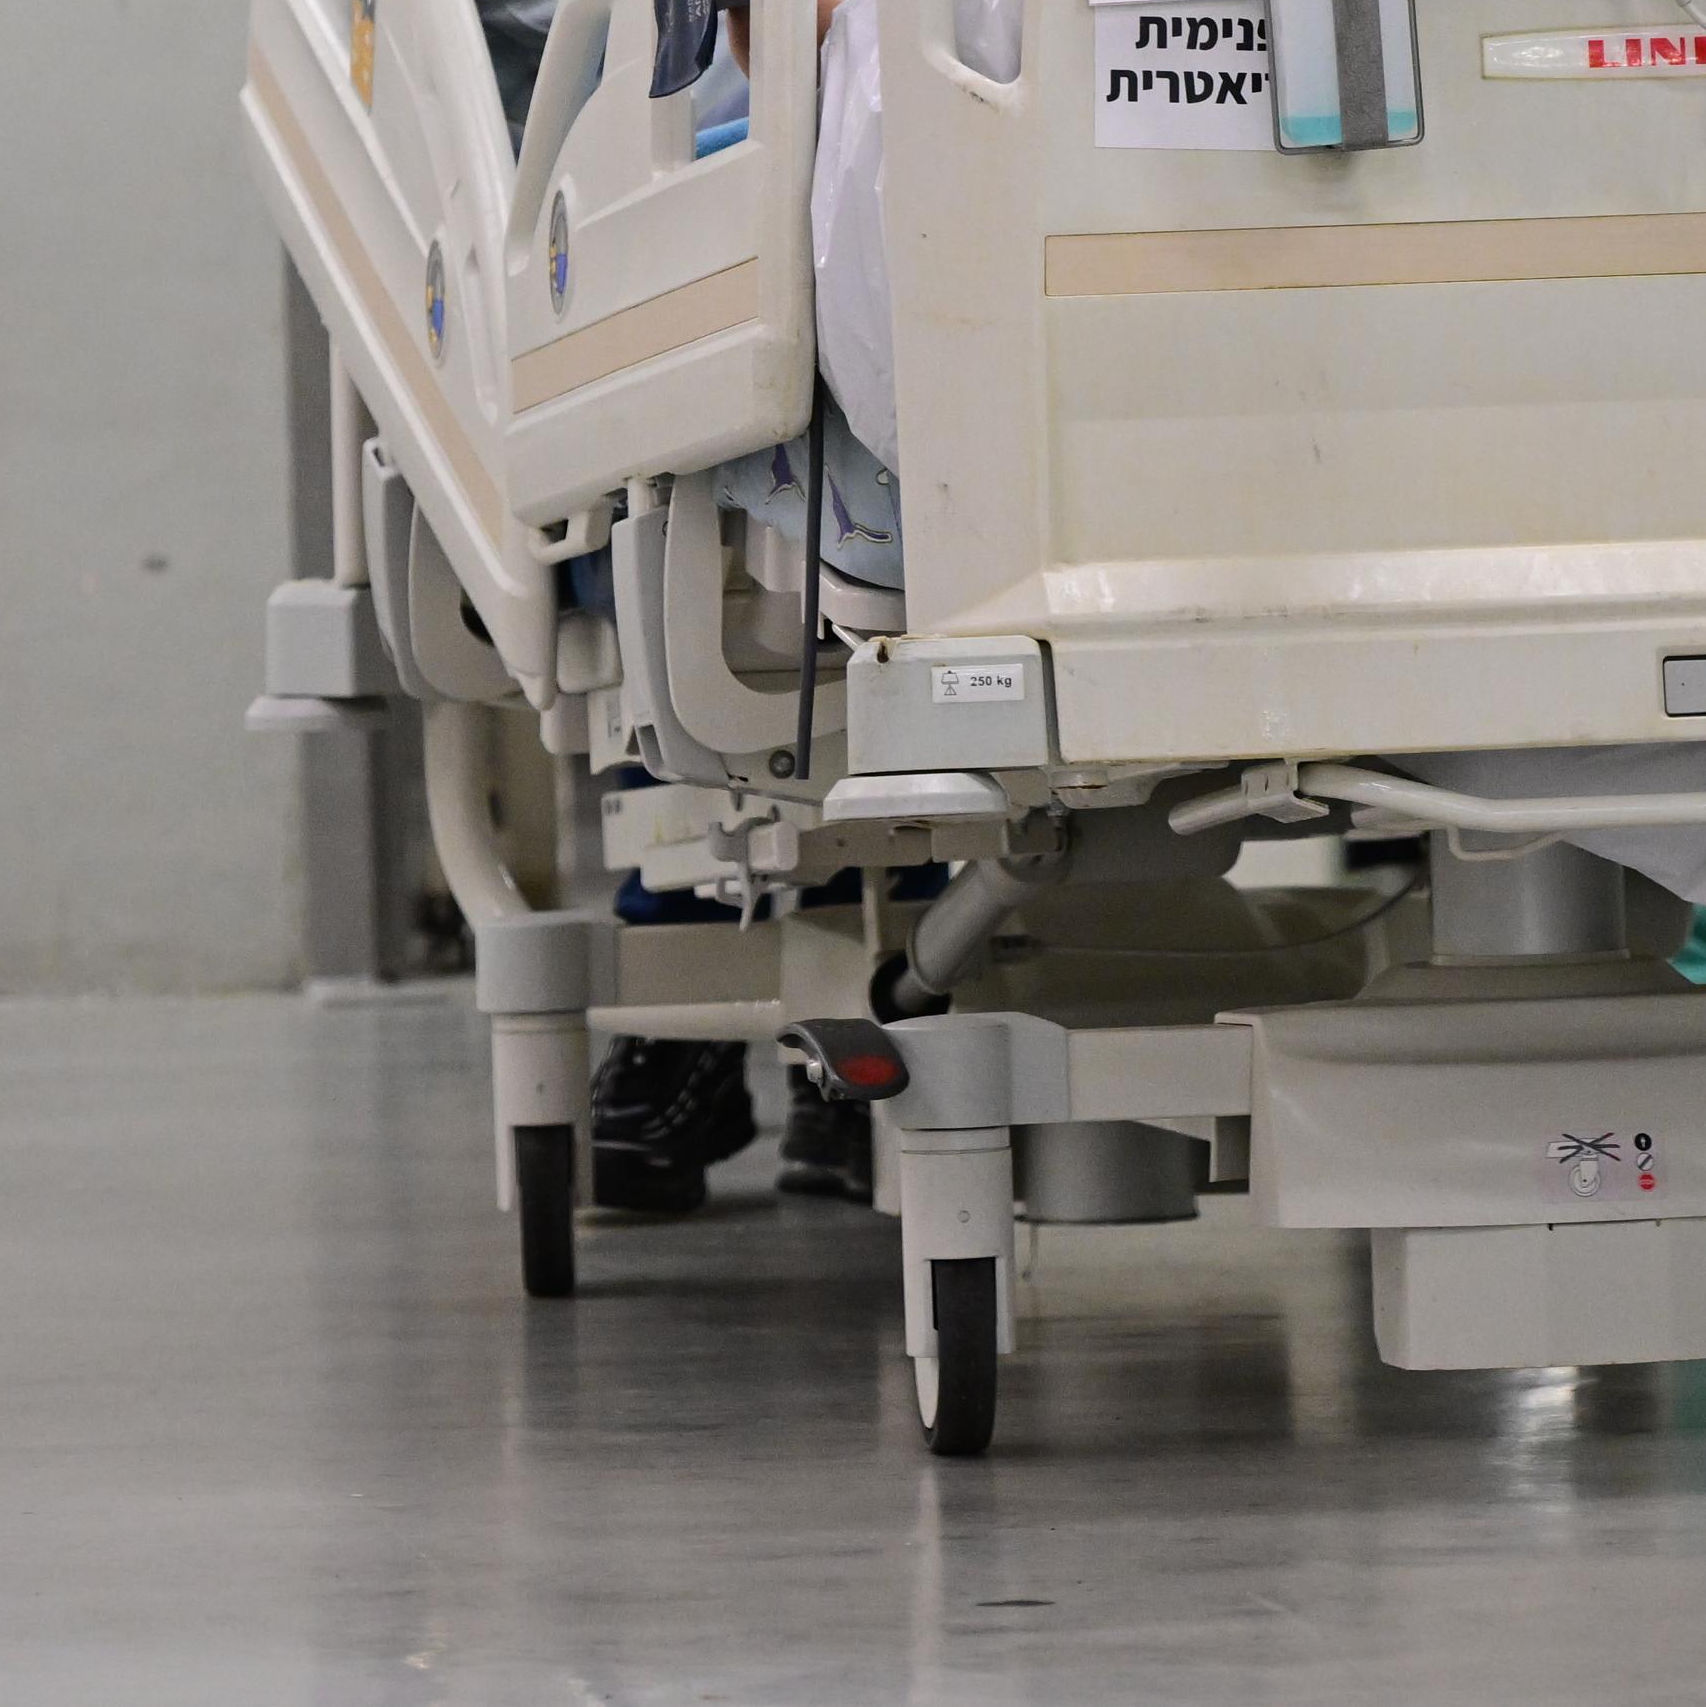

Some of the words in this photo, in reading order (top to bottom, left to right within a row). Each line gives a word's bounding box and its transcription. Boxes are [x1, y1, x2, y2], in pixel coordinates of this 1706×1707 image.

[1106, 69, 1270, 105] יאטרית
[970, 675, 993, 687] 250
[996, 674, 1012, 688] kg
